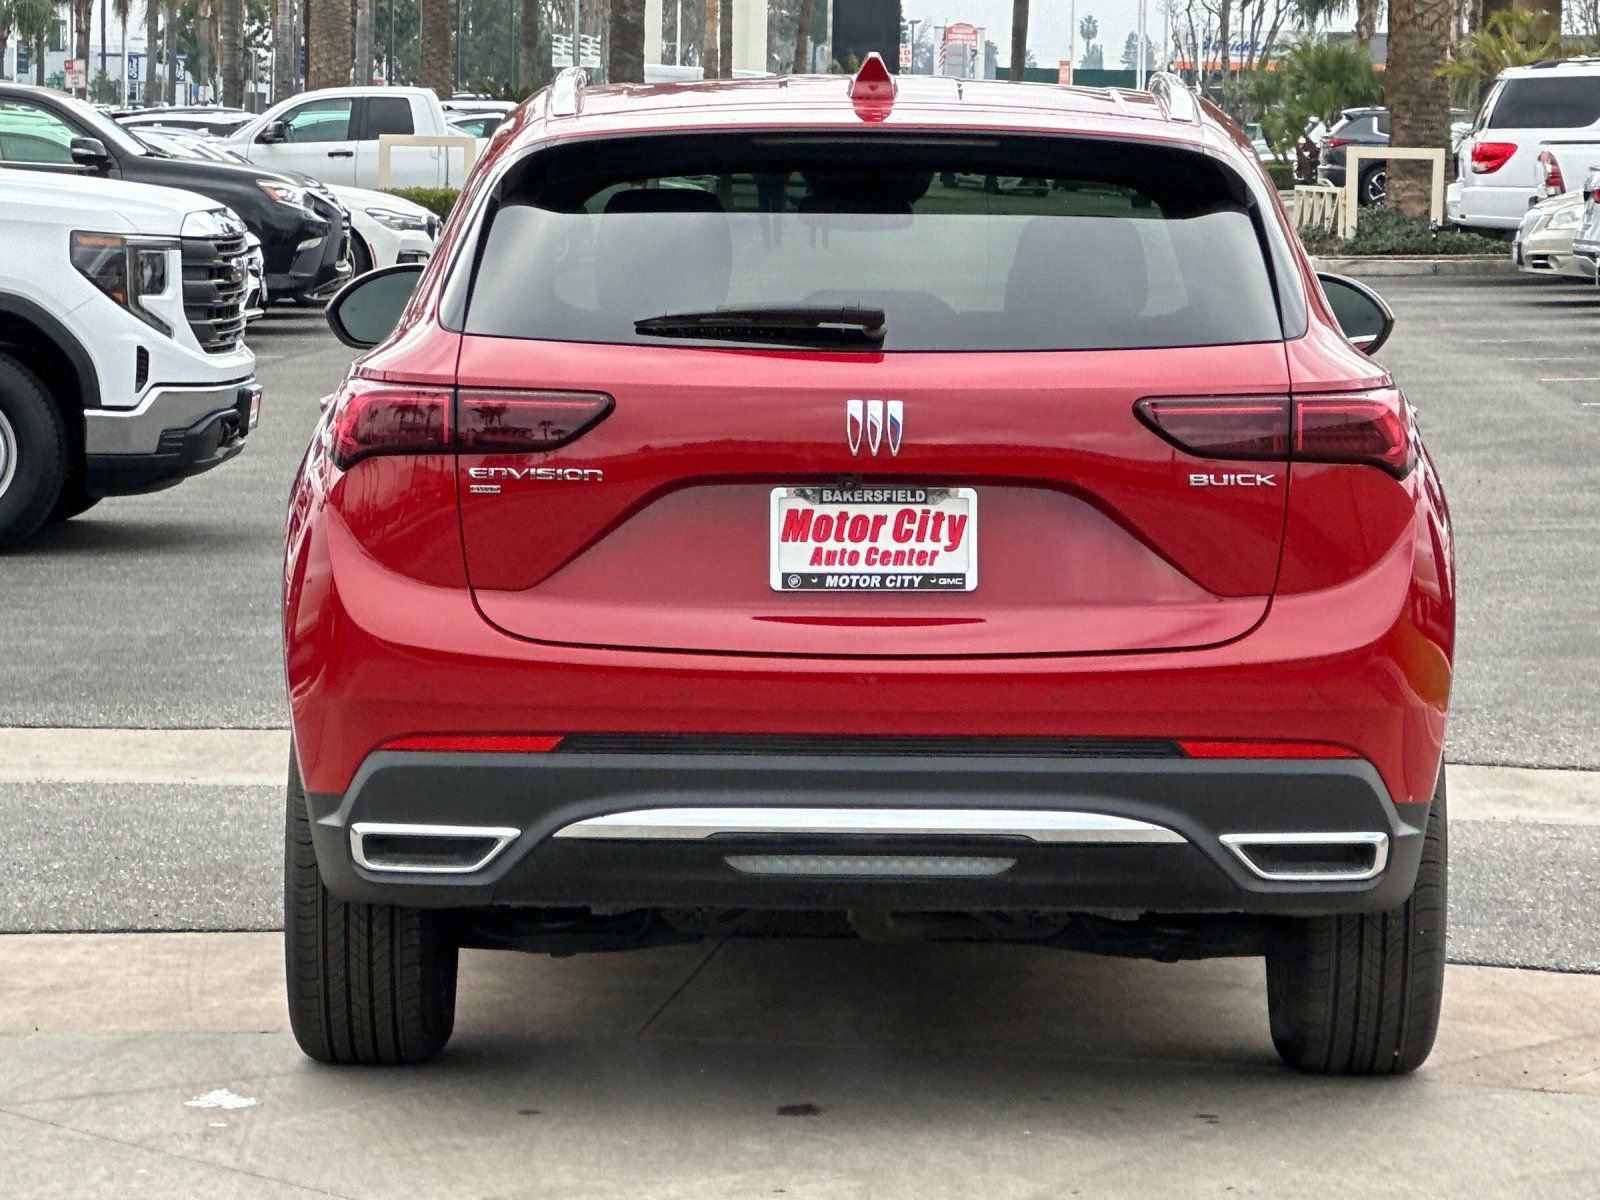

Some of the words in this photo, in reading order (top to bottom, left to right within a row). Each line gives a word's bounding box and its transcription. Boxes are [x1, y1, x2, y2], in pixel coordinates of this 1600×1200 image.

[468, 467, 603, 481] ENVISION
[1189, 474, 1277, 486] BUICK
[822, 489, 926, 502] BAKERSFIELD
[781, 508, 888, 543] Motor
[892, 508, 968, 552] City
[809, 546, 860, 566] Auto
[864, 546, 939, 566] Center
[825, 575, 881, 588] MOTOR
[885, 575, 923, 588] CITY
[938, 577, 963, 585] GMC
